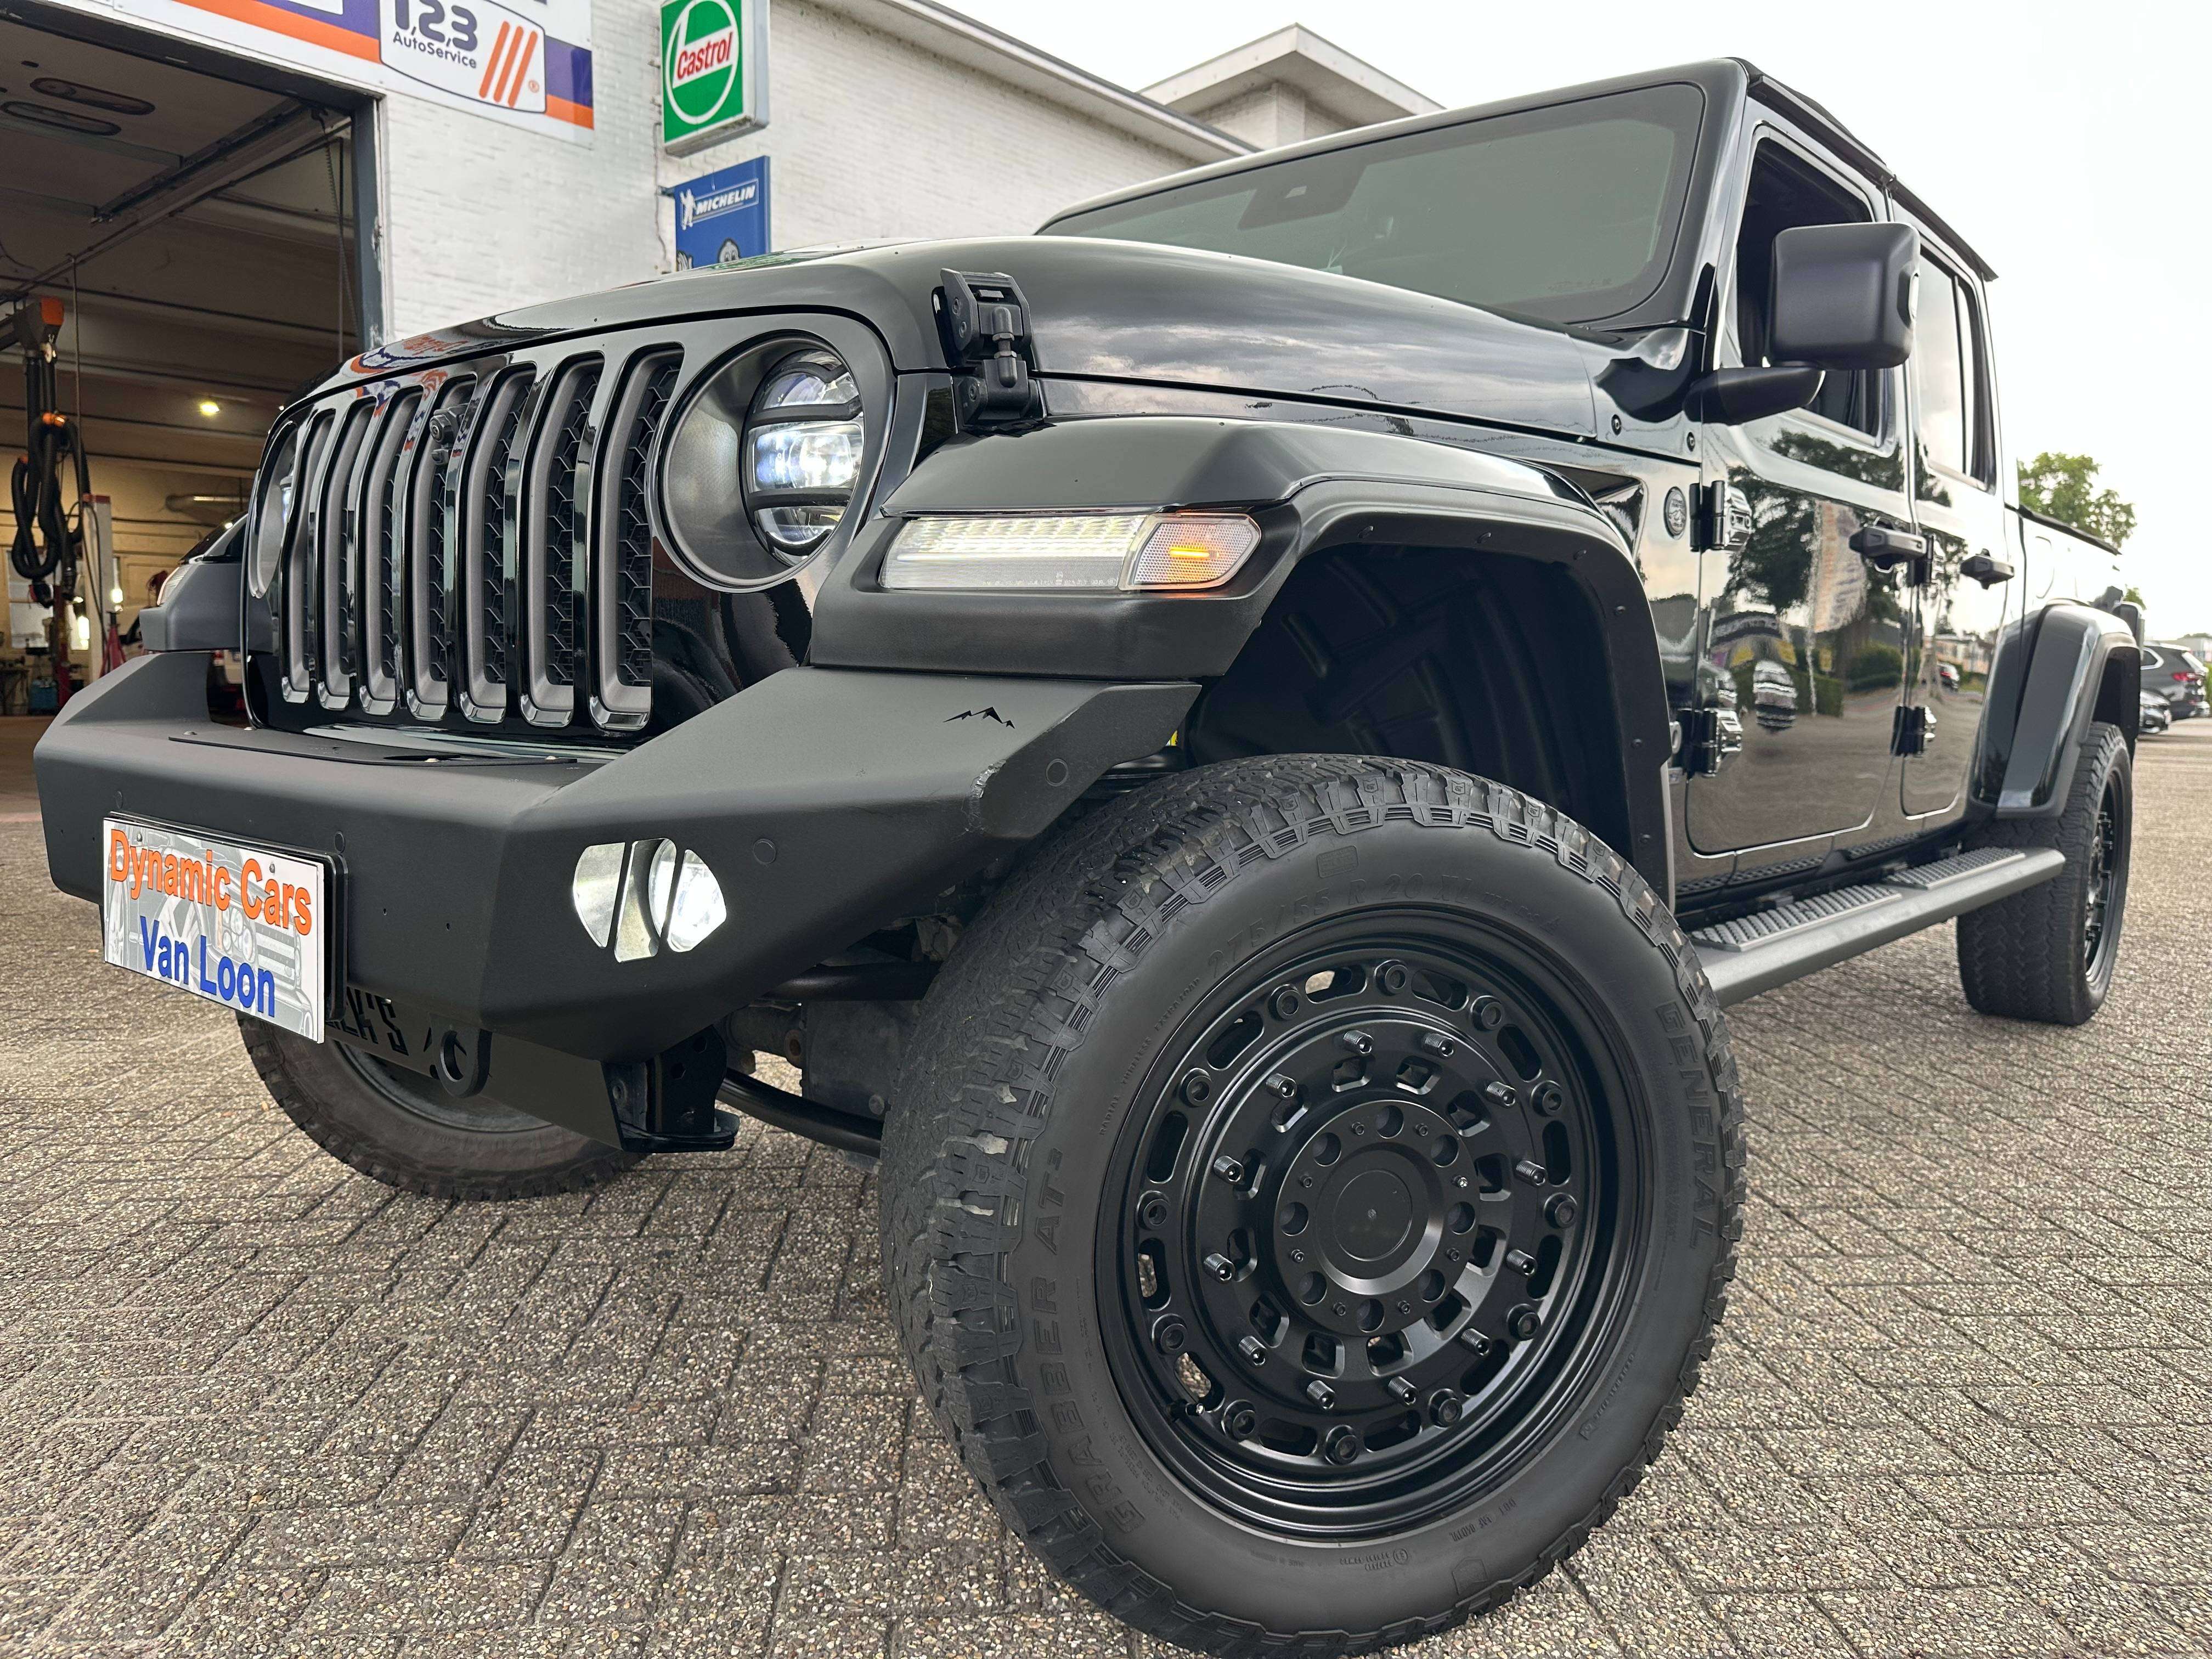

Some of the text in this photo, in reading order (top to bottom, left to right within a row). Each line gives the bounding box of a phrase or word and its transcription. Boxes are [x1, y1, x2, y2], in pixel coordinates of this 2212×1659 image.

[393, 31, 477, 69] AutoService
[677, 31, 733, 80] Castrol
[696, 185, 756, 215] MICHELIN
[111, 829, 312, 935] Dynamic Cars
[1208, 889, 1330, 978] 275/55
[1347, 879, 1367, 906] R
[1381, 873, 1425, 900] 20
[1432, 874, 1474, 905] XL
[140, 916, 275, 1018] Van Loon
[1655, 1001, 1717, 1249] GENERAL
[1032, 1277, 1146, 1532] GRABBER
